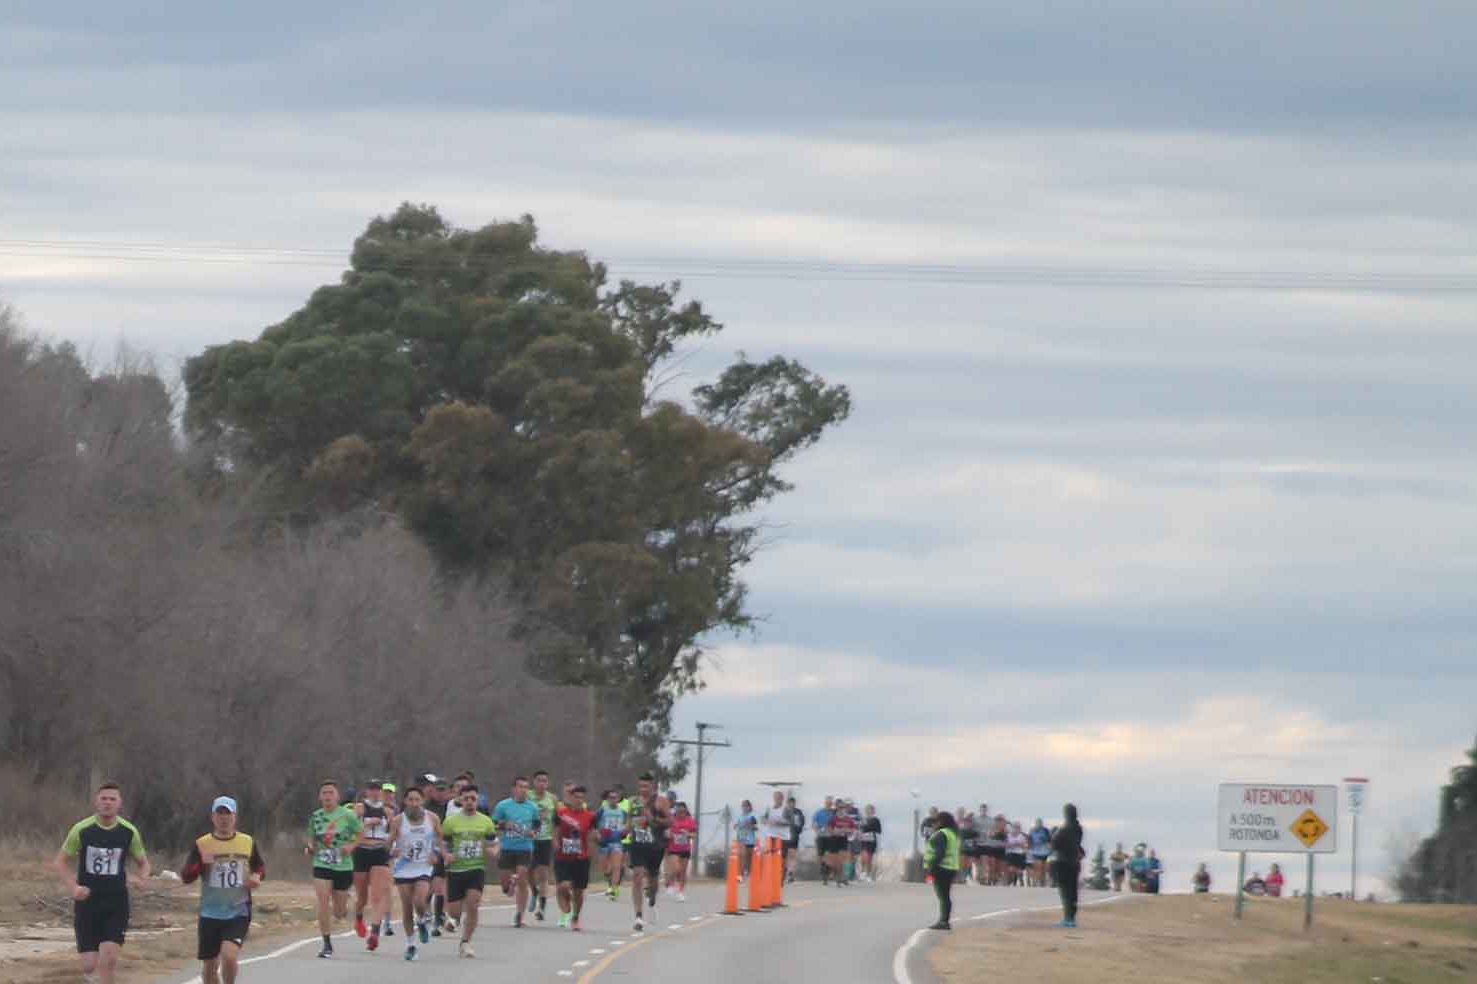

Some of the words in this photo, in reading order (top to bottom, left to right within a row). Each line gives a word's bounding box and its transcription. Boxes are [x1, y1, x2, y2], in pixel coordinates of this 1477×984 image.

[1243, 788, 1315, 806] ATENCION
[1228, 828, 1280, 841] ROTONDA
[92, 856, 112, 875] 61
[219, 870, 238, 888] 10
